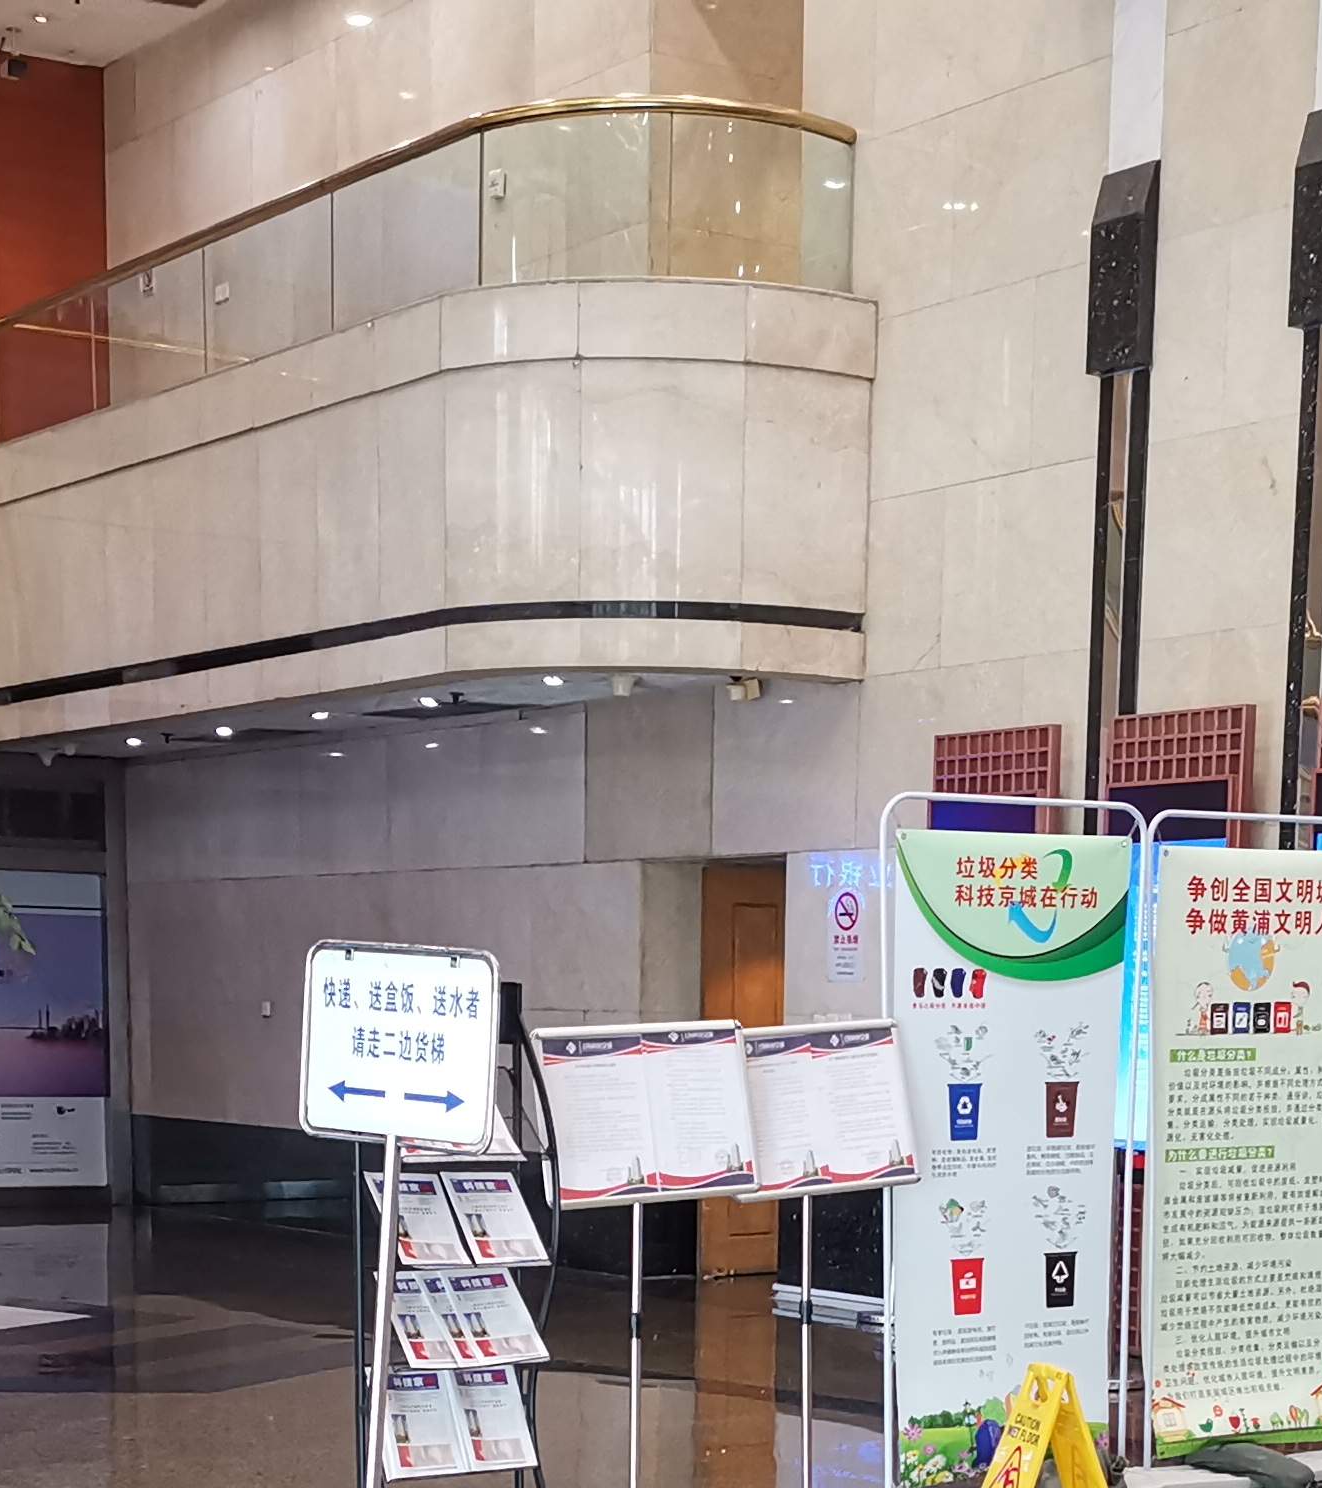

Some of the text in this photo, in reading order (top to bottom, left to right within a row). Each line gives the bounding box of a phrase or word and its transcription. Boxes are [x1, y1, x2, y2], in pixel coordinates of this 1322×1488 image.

[956, 855, 1038, 880] 垃圾分类
[954, 883, 1098, 909] 科技京城在行动
[323, 976, 480, 1019] 快递、送盒饭、送水者
[351, 1026, 445, 1064] 请走二边货梯
[1014, 1412, 1041, 1431] CAUTION
[1019, 1429, 1041, 1447] FLOOR
